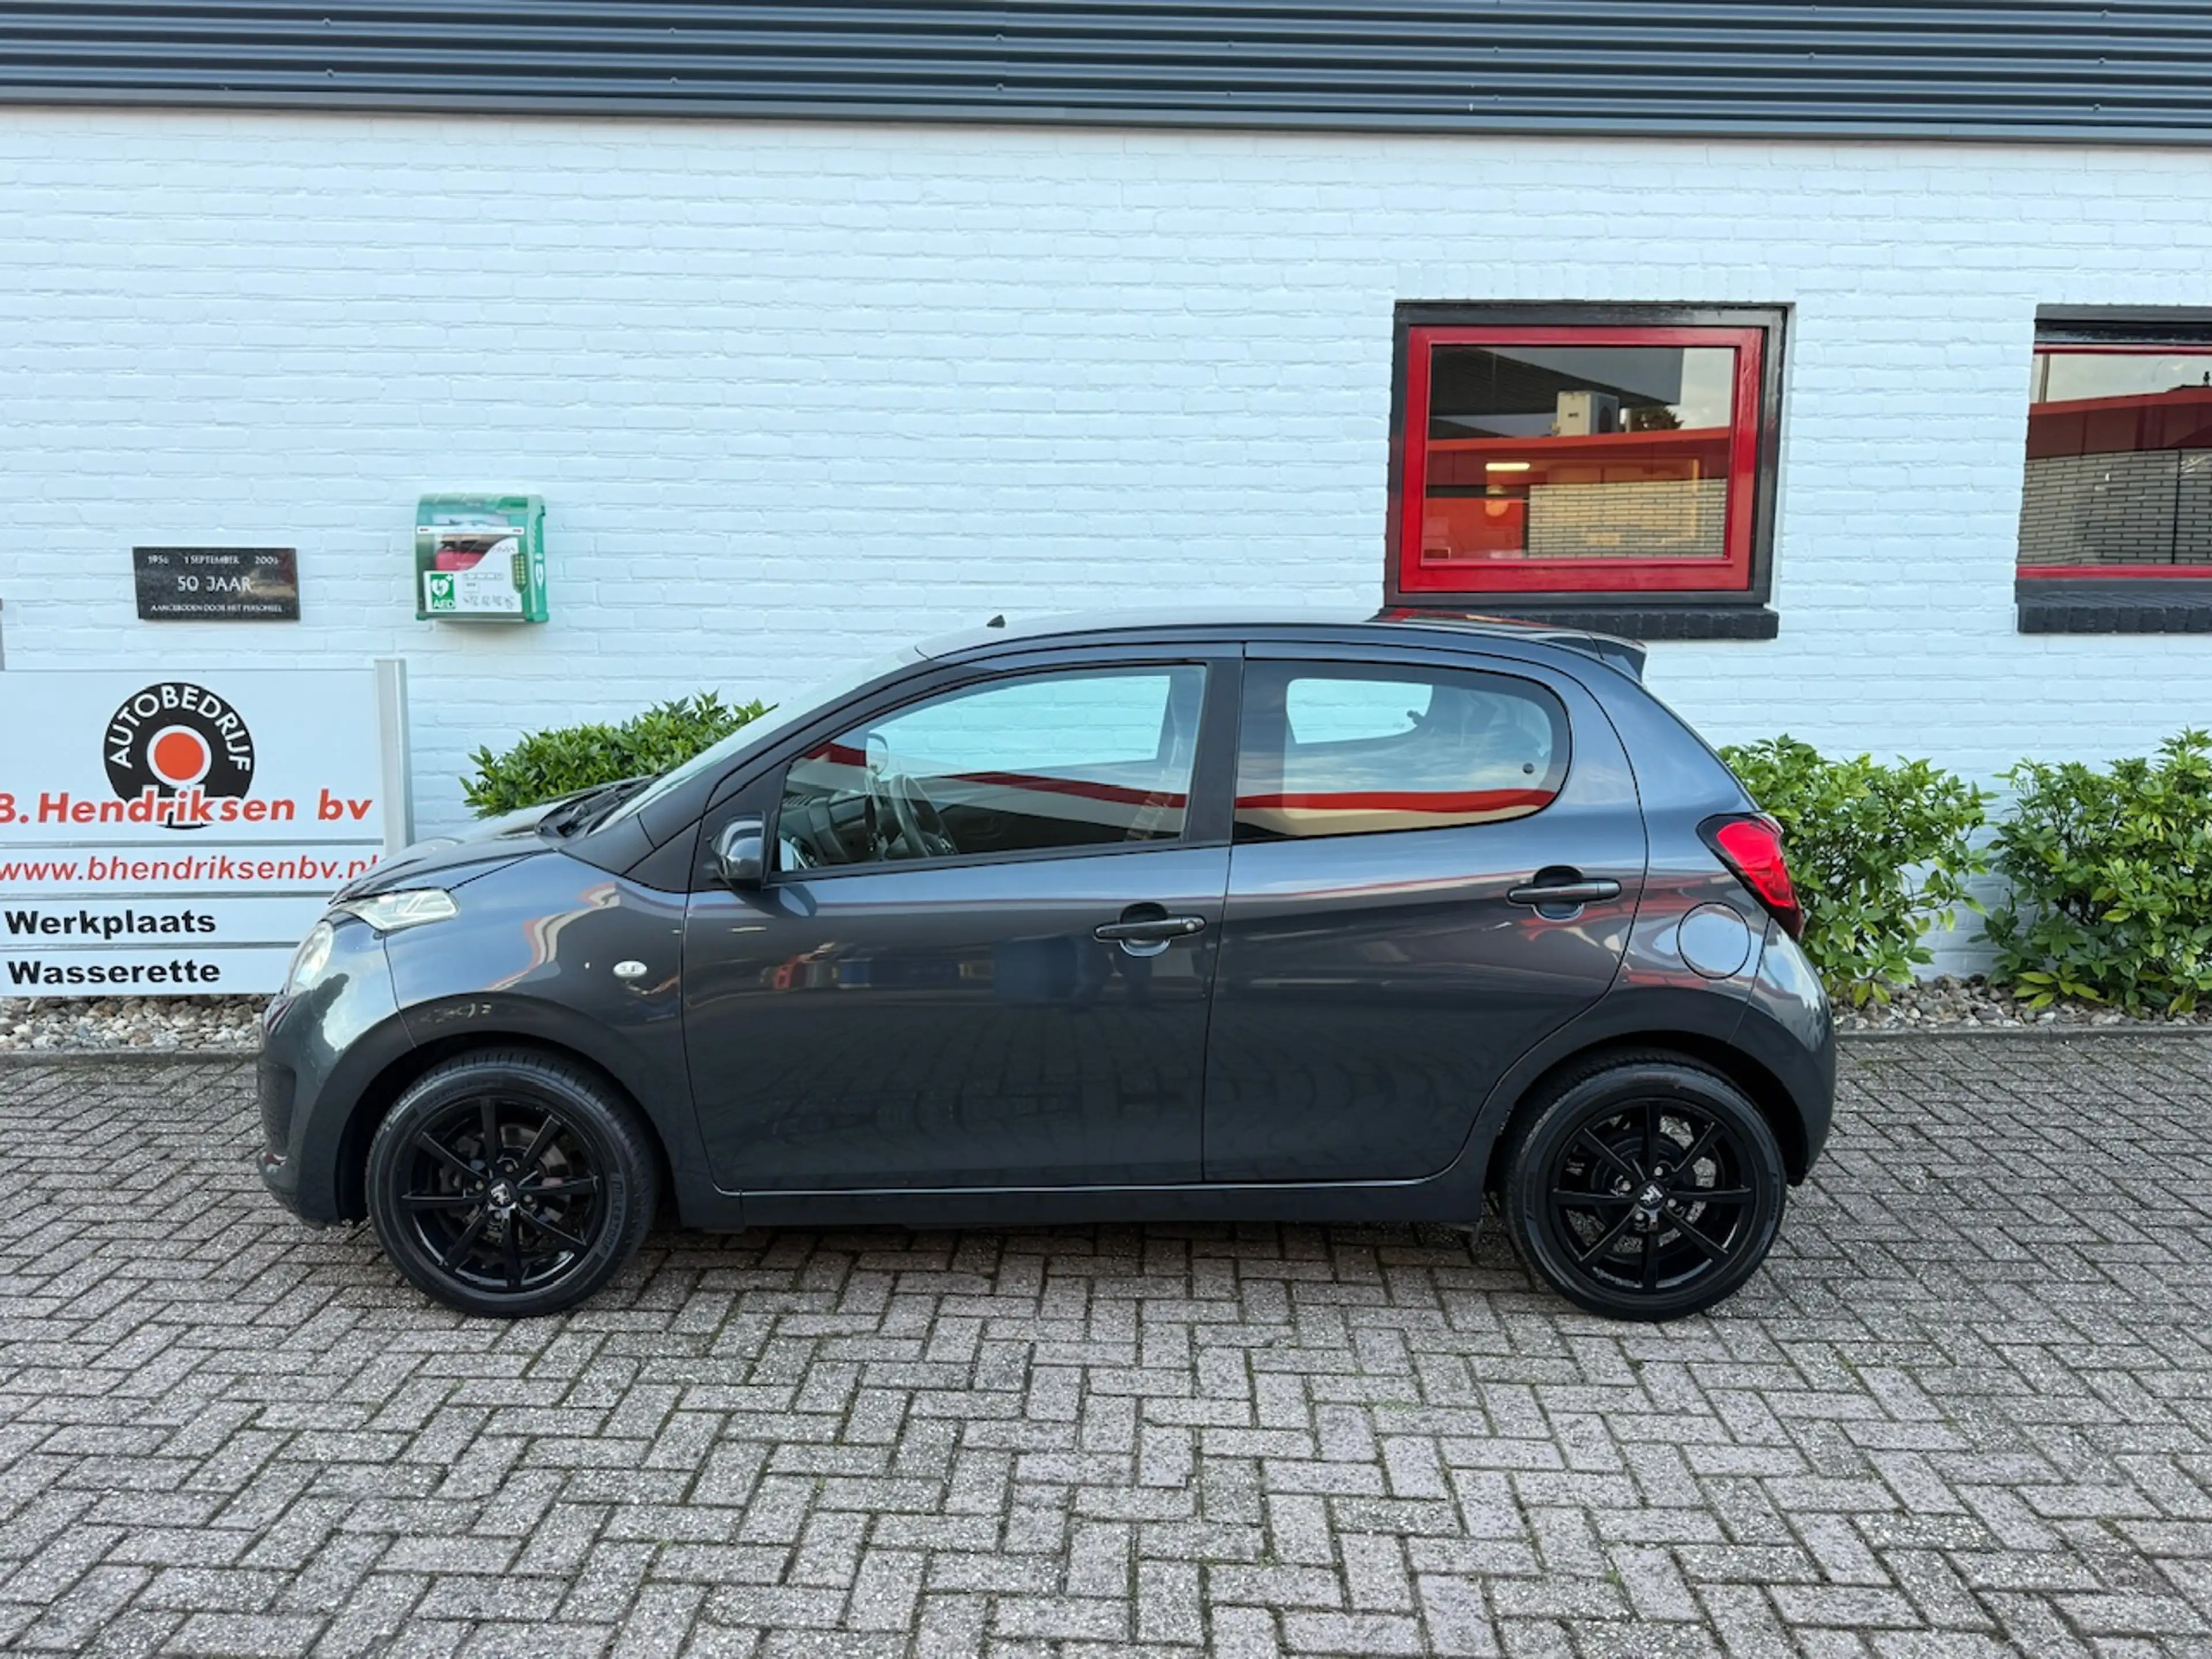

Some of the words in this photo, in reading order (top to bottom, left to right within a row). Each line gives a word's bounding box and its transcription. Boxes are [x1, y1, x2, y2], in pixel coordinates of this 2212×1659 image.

[191, 555, 240, 565] SEPTEMBER
[177, 575, 199, 592] 50
[206, 576, 252, 593] JAAR
[109, 684, 251, 771] AUTOBEDRIJF
[0, 793, 28, 824] B.
[38, 790, 295, 823] Hendriksen
[317, 789, 372, 820] bv
[5, 910, 216, 940] Werkplaats
[7, 960, 221, 984] Wasserette
